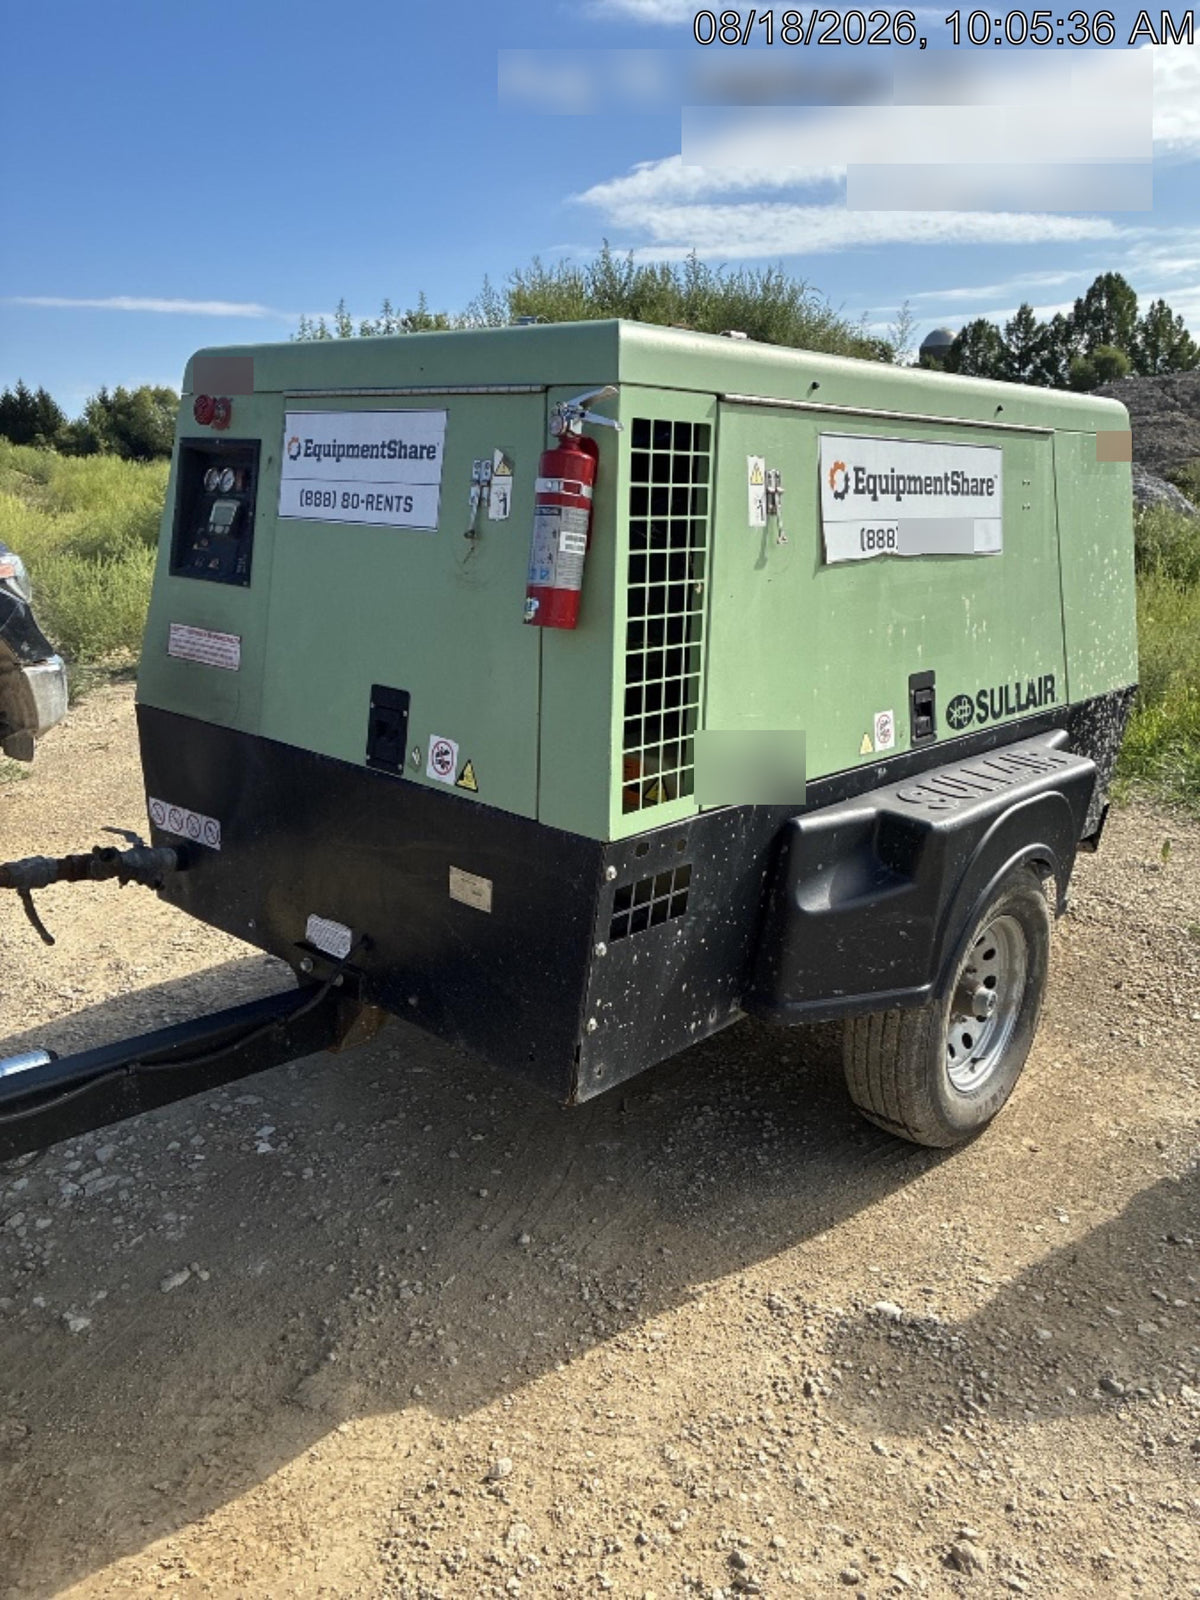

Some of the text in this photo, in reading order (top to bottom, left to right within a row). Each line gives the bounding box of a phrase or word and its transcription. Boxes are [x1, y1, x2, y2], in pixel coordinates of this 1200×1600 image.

[303, 438, 437, 462] EquipmentShare
[852, 466, 996, 502] EquipmentShare
[299, 489, 414, 513] (888) 80-RENTS
[976, 674, 1055, 724] SULLAIR
